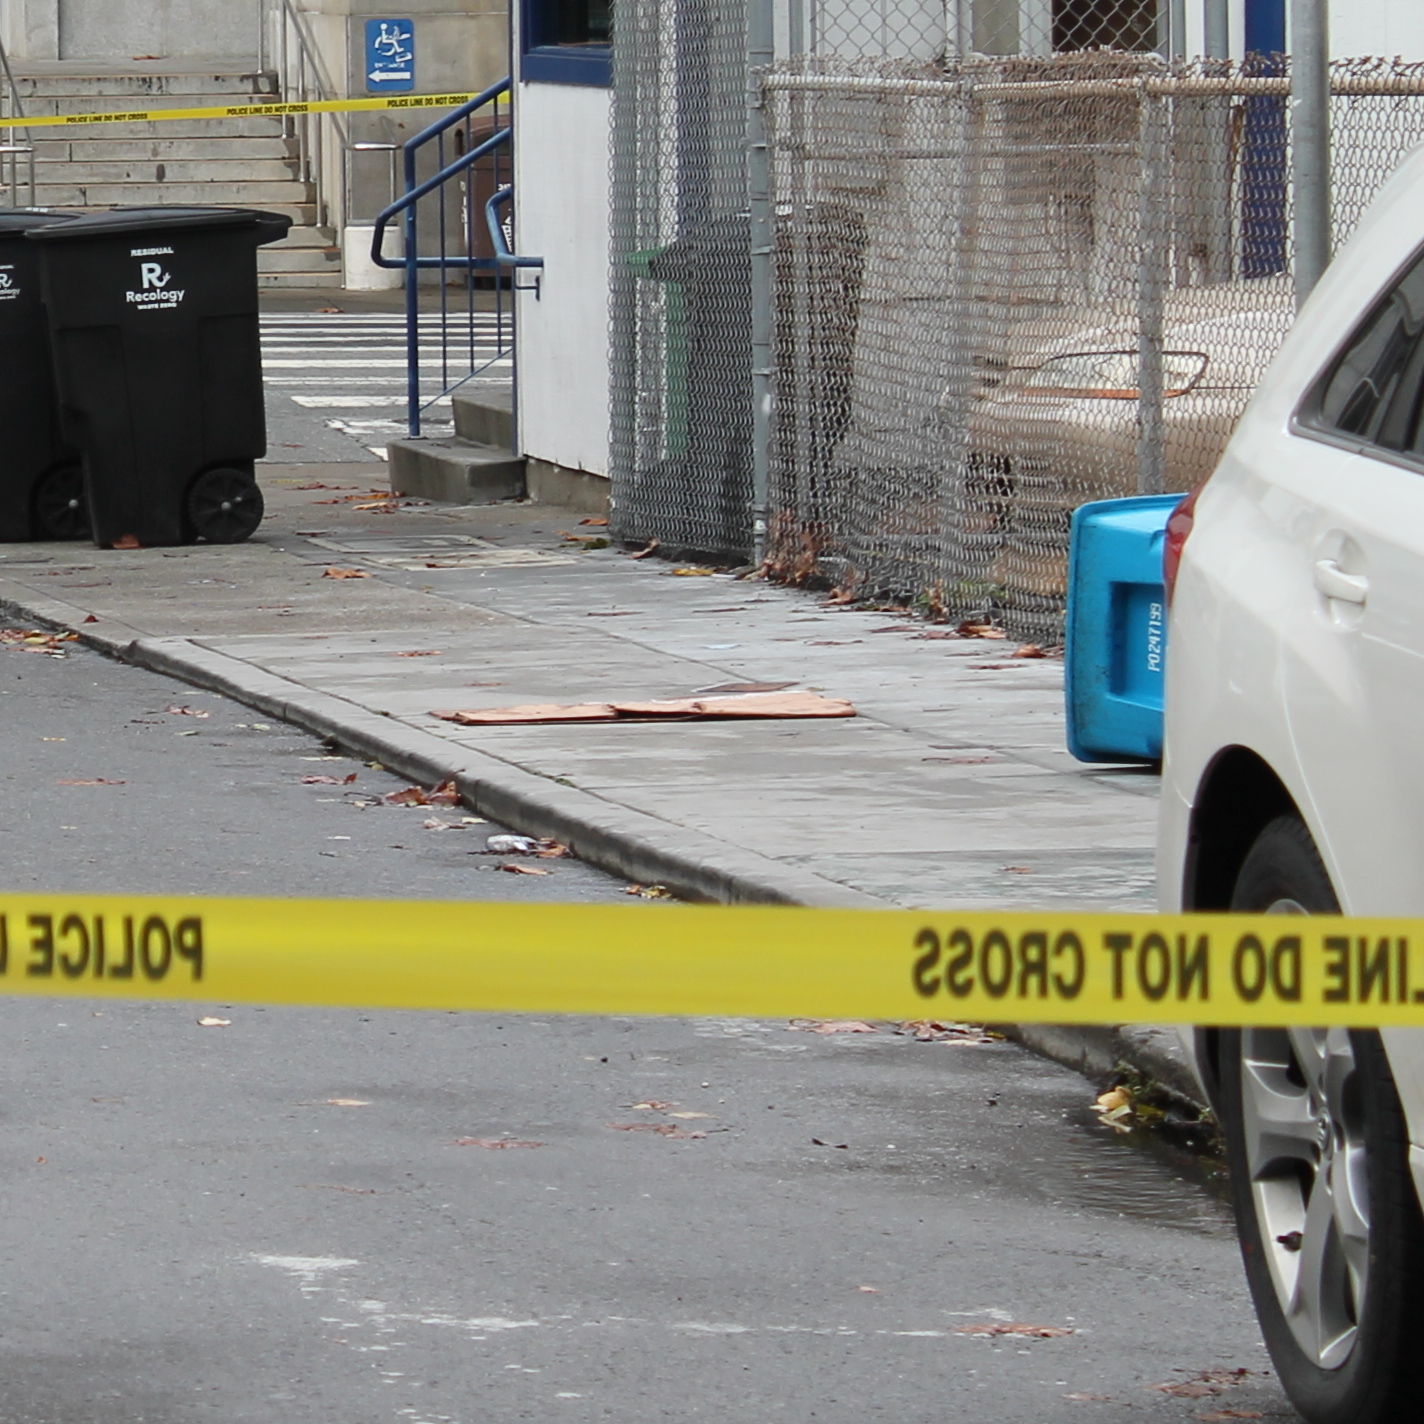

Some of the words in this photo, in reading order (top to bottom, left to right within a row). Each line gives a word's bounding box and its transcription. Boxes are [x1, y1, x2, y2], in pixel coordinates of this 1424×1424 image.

[387, 99, 408, 107] POLICE
[410, 98, 423, 106] LINE
[425, 97, 433, 106] DO
[435, 97, 448, 105] NOT
[449, 96, 469, 104] CROSS
[274, 105, 287, 113] NOT
[131, 247, 174, 257] RESIDUAL
[126, 288, 185, 303] Recology
